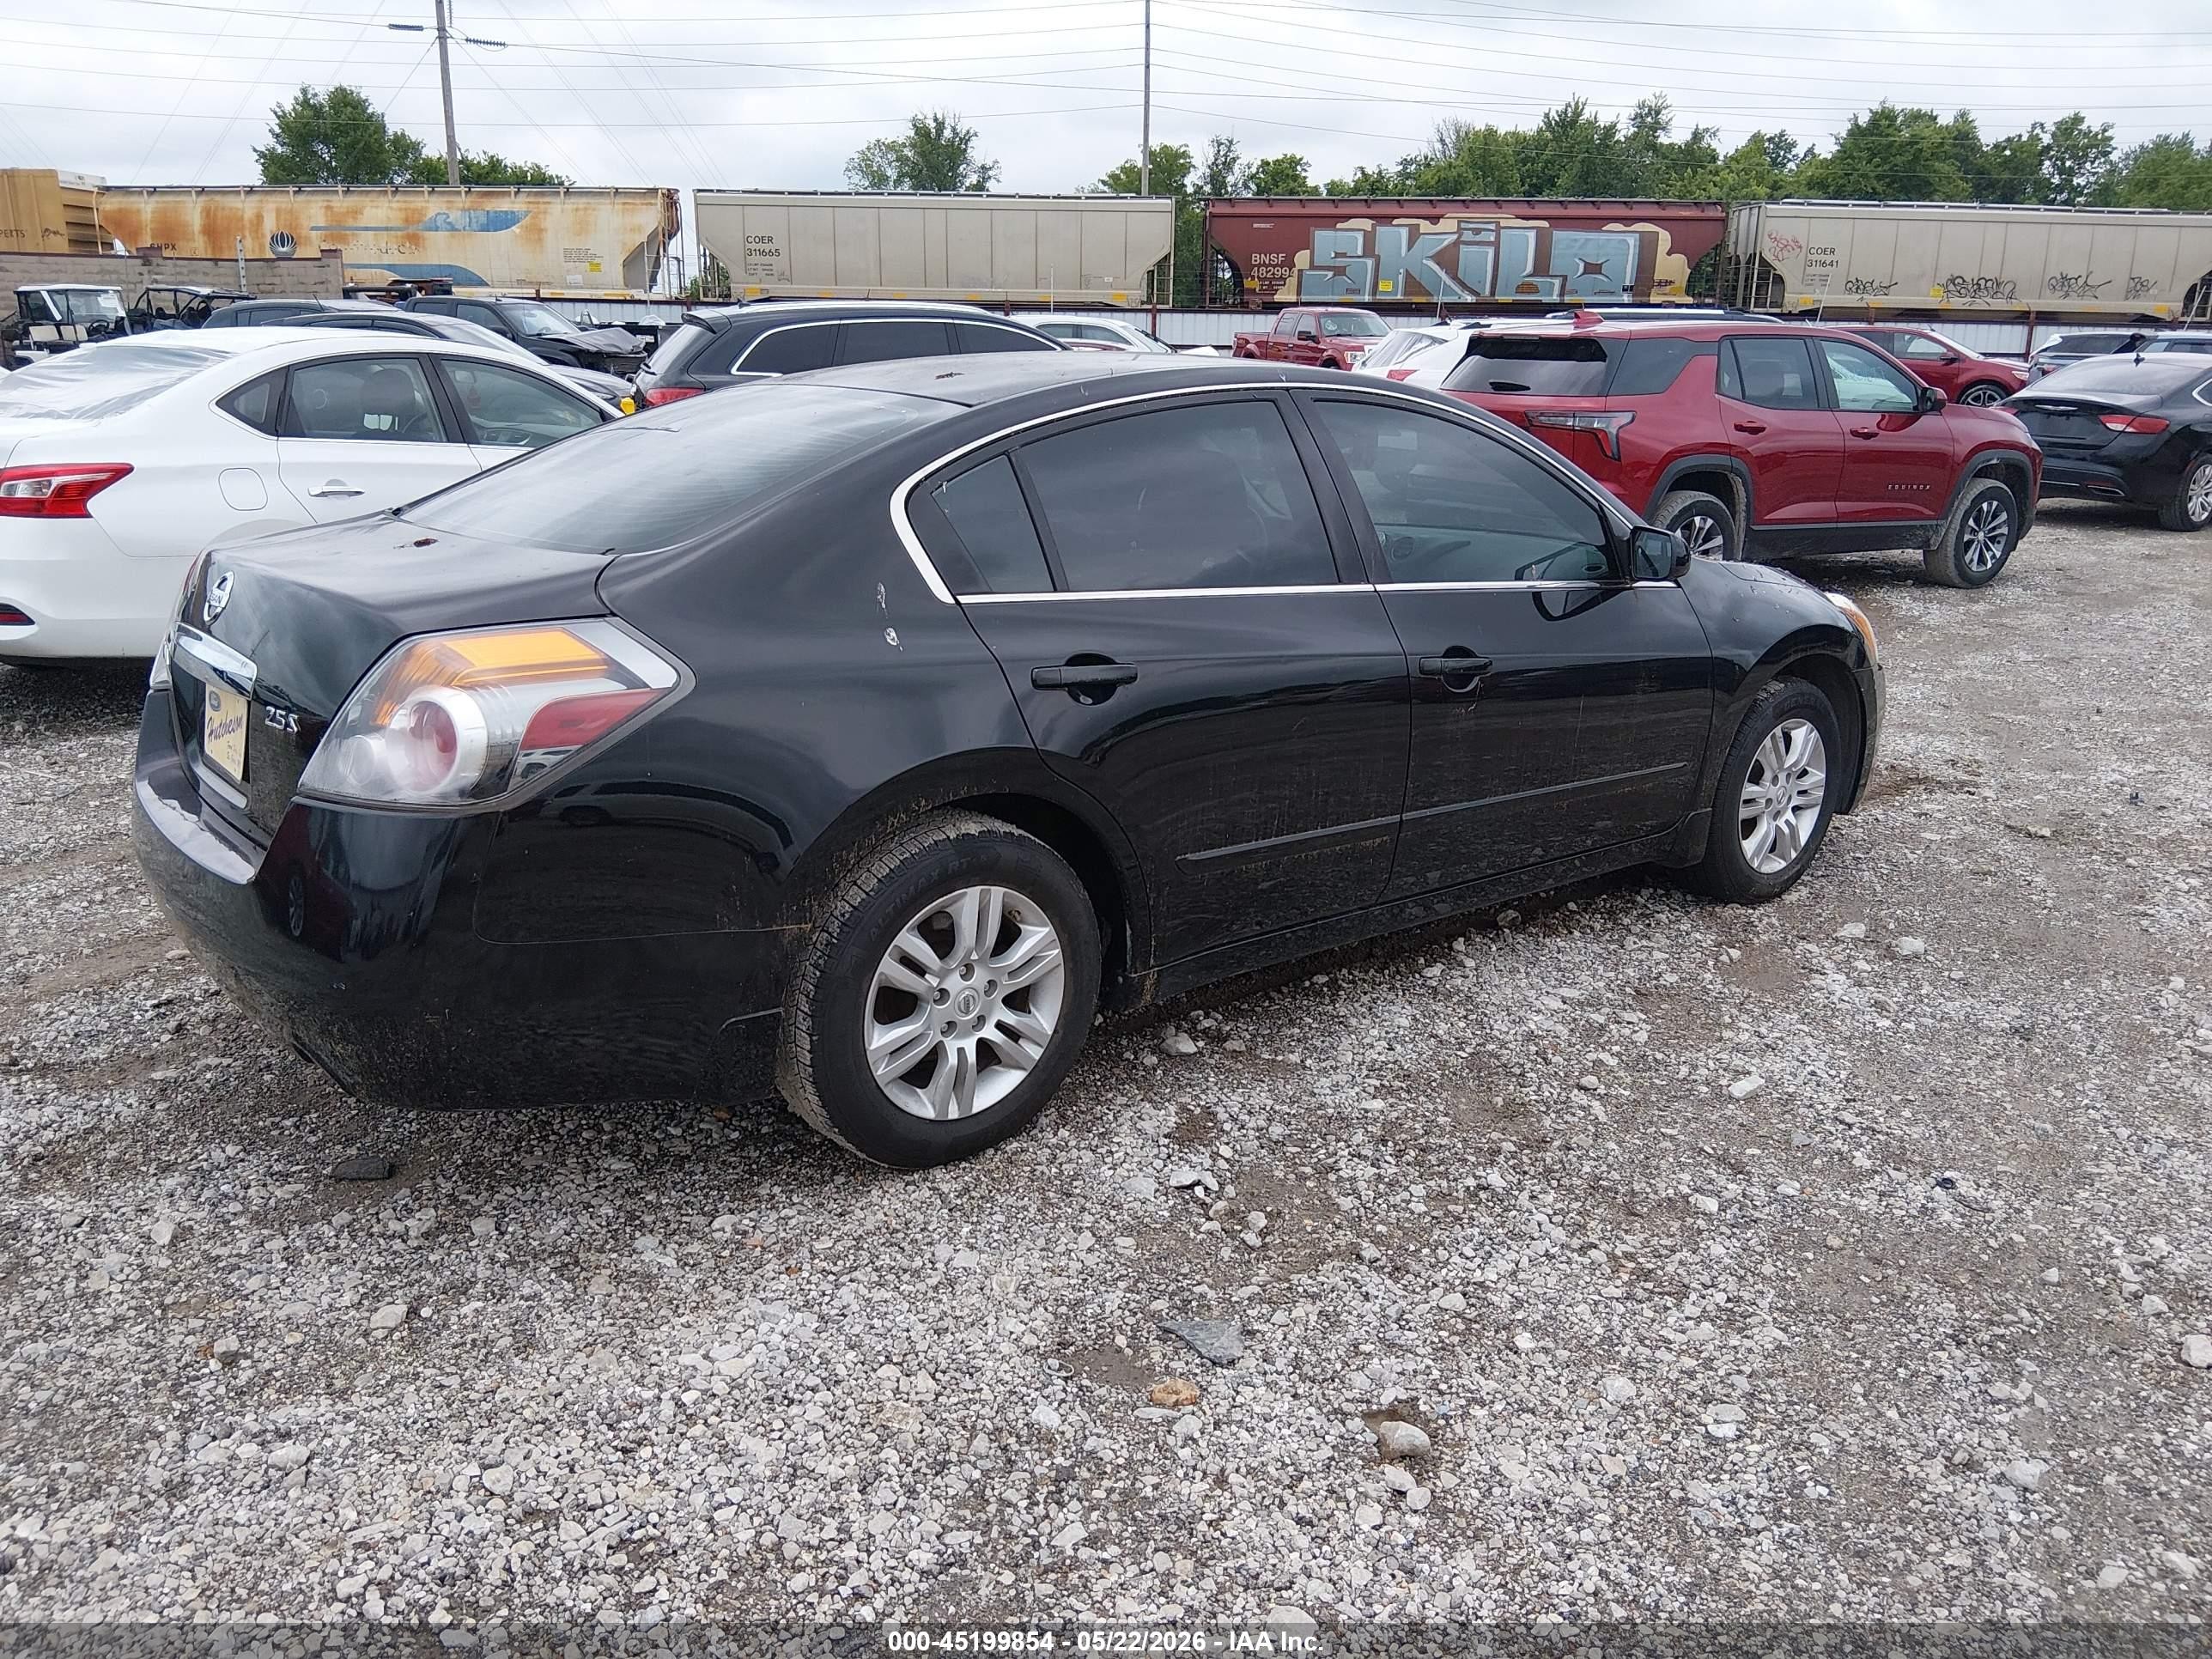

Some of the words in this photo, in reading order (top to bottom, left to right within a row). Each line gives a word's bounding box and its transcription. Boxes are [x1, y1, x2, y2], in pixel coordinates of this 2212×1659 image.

[746, 235, 774, 244] COER
[746, 247, 781, 257] 311665
[1808, 246, 1836, 256] COER
[1251, 253, 1286, 264] BNSF
[1807, 259, 1839, 268] 311641
